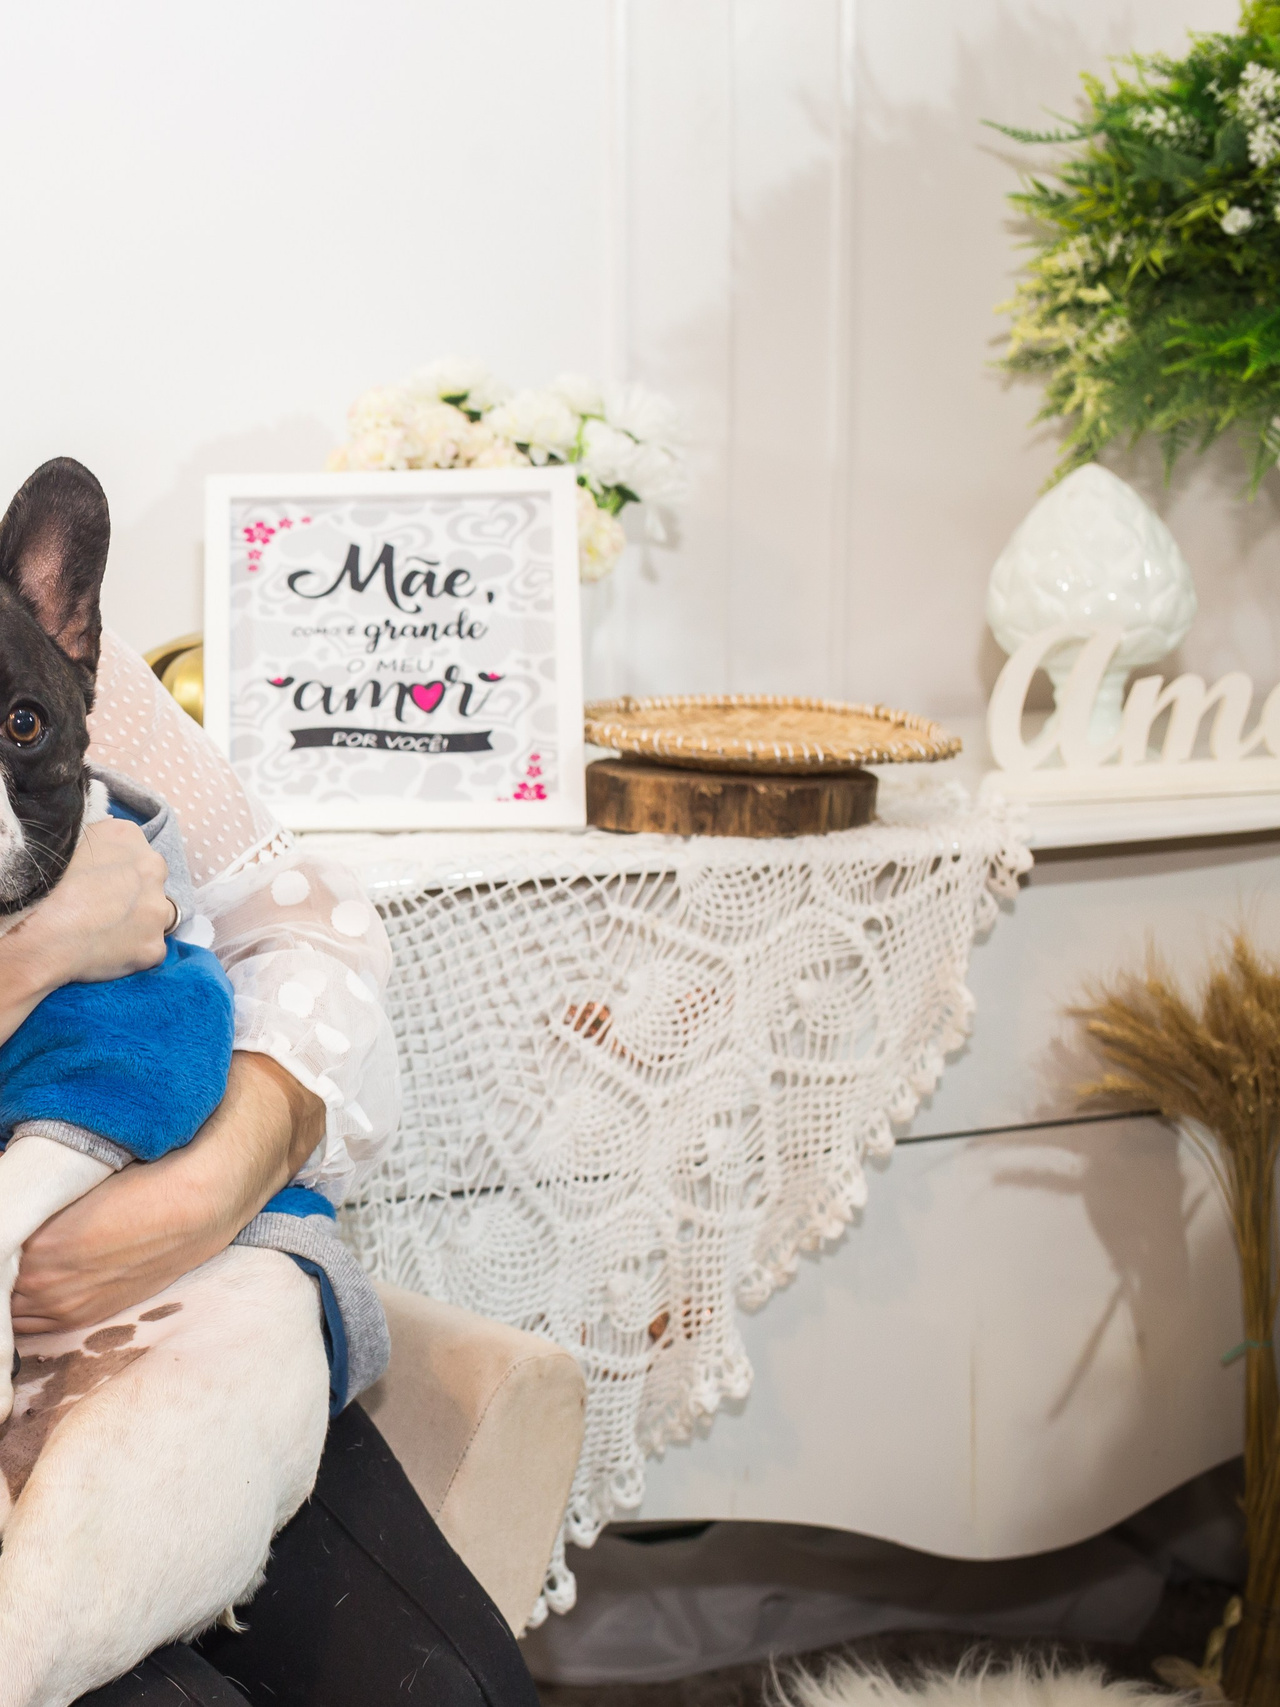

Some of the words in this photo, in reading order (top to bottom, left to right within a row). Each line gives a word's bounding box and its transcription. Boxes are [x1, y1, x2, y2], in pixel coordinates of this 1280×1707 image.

[287, 542, 494, 614] Mãe,
[364, 609, 488, 653] grande
[376, 657, 434, 673] MEU
[332, 731, 379, 748] POR
[384, 734, 449, 753] VOCÊ!
